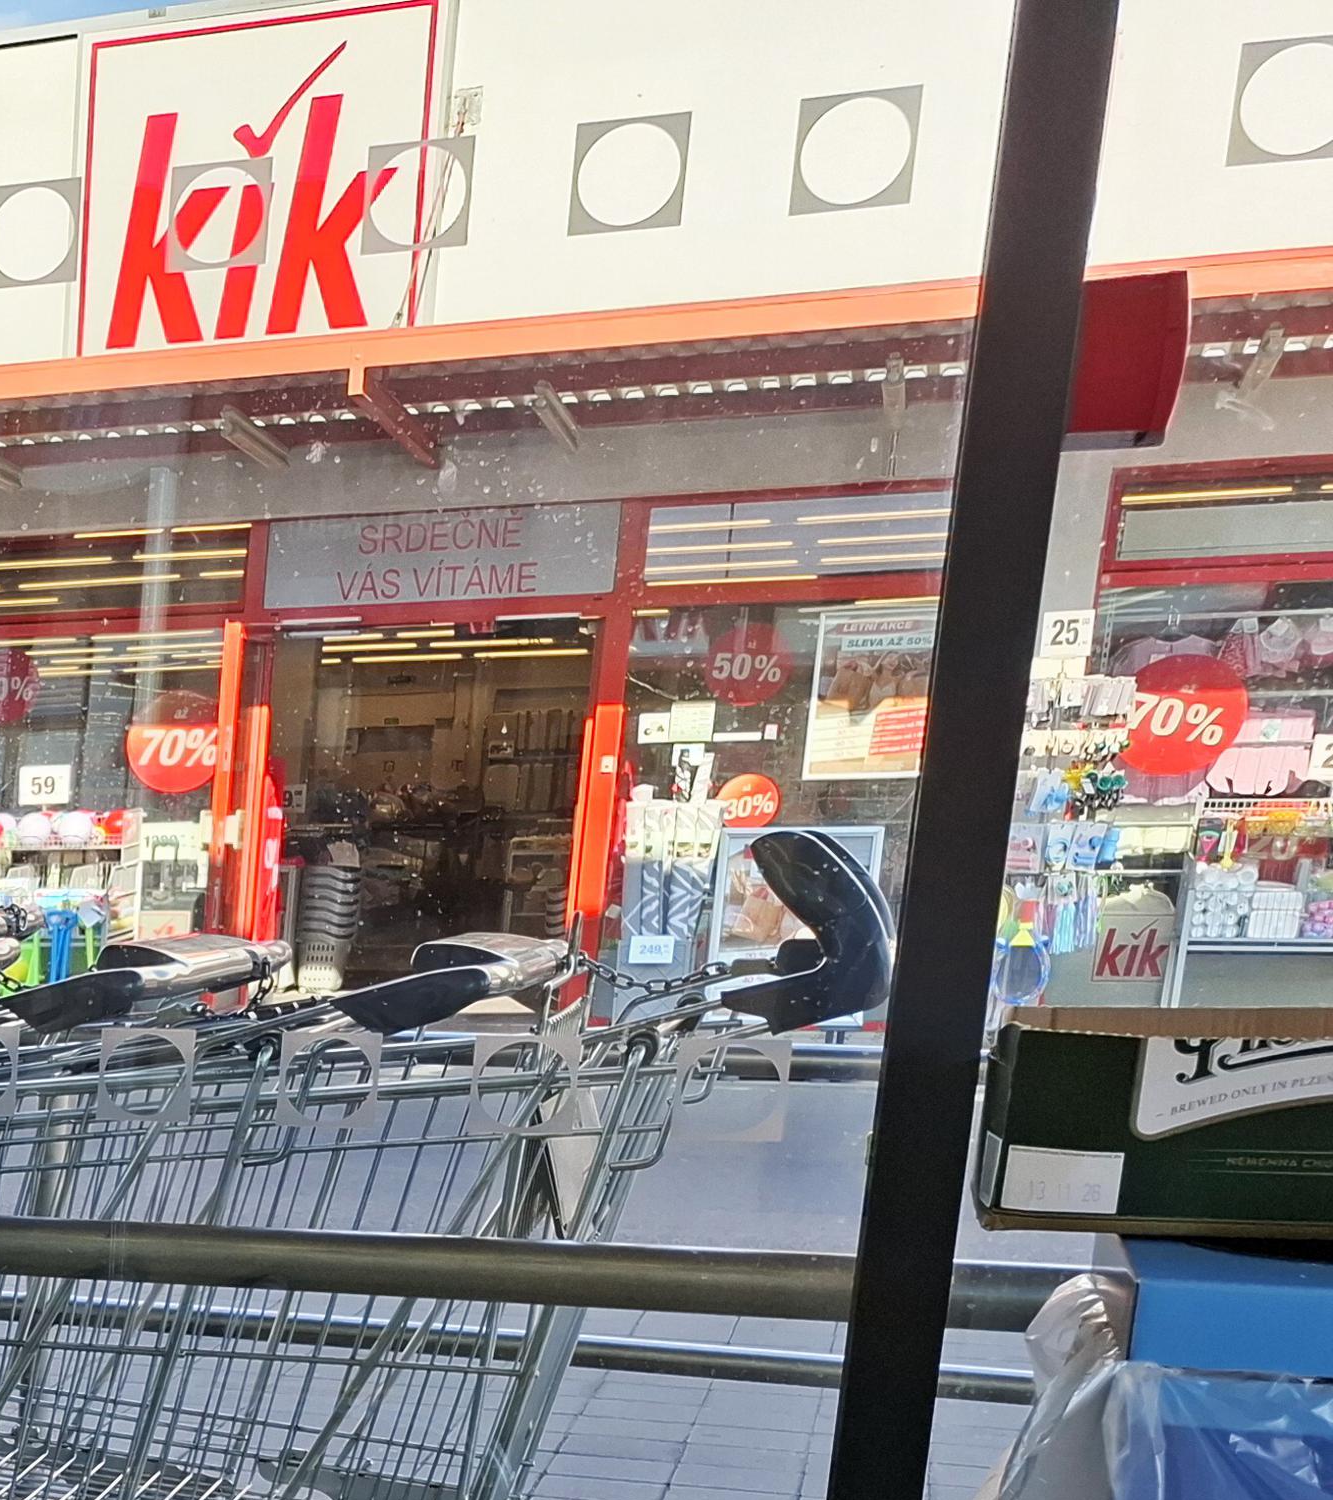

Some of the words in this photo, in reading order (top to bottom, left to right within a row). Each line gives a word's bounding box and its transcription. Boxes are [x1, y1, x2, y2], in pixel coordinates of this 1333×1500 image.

[105, 41, 400, 350] kik
[358, 512, 524, 556] SRDEČNĚ
[336, 563, 402, 601] VÁS
[414, 559, 539, 598] VÍTÁME
[842, 621, 878, 633] LETNÍ
[879, 620, 914, 631] AKCE
[846, 637, 884, 649] SLEVA
[886, 635, 904, 647] AŽ
[1050, 618, 1080, 646] 25
[711, 652, 782, 683] 50%
[1127, 693, 1225, 747] 70%
[138, 727, 218, 768] 70%
[29, 776, 56, 796] 59
[723, 793, 775, 821] 30%
[1095, 918, 1169, 978] kik
[1169, 1092, 1229, 1116] BREWED
[1230, 1083, 1268, 1100] ONLY
[1271, 1079, 1289, 1091] IN
